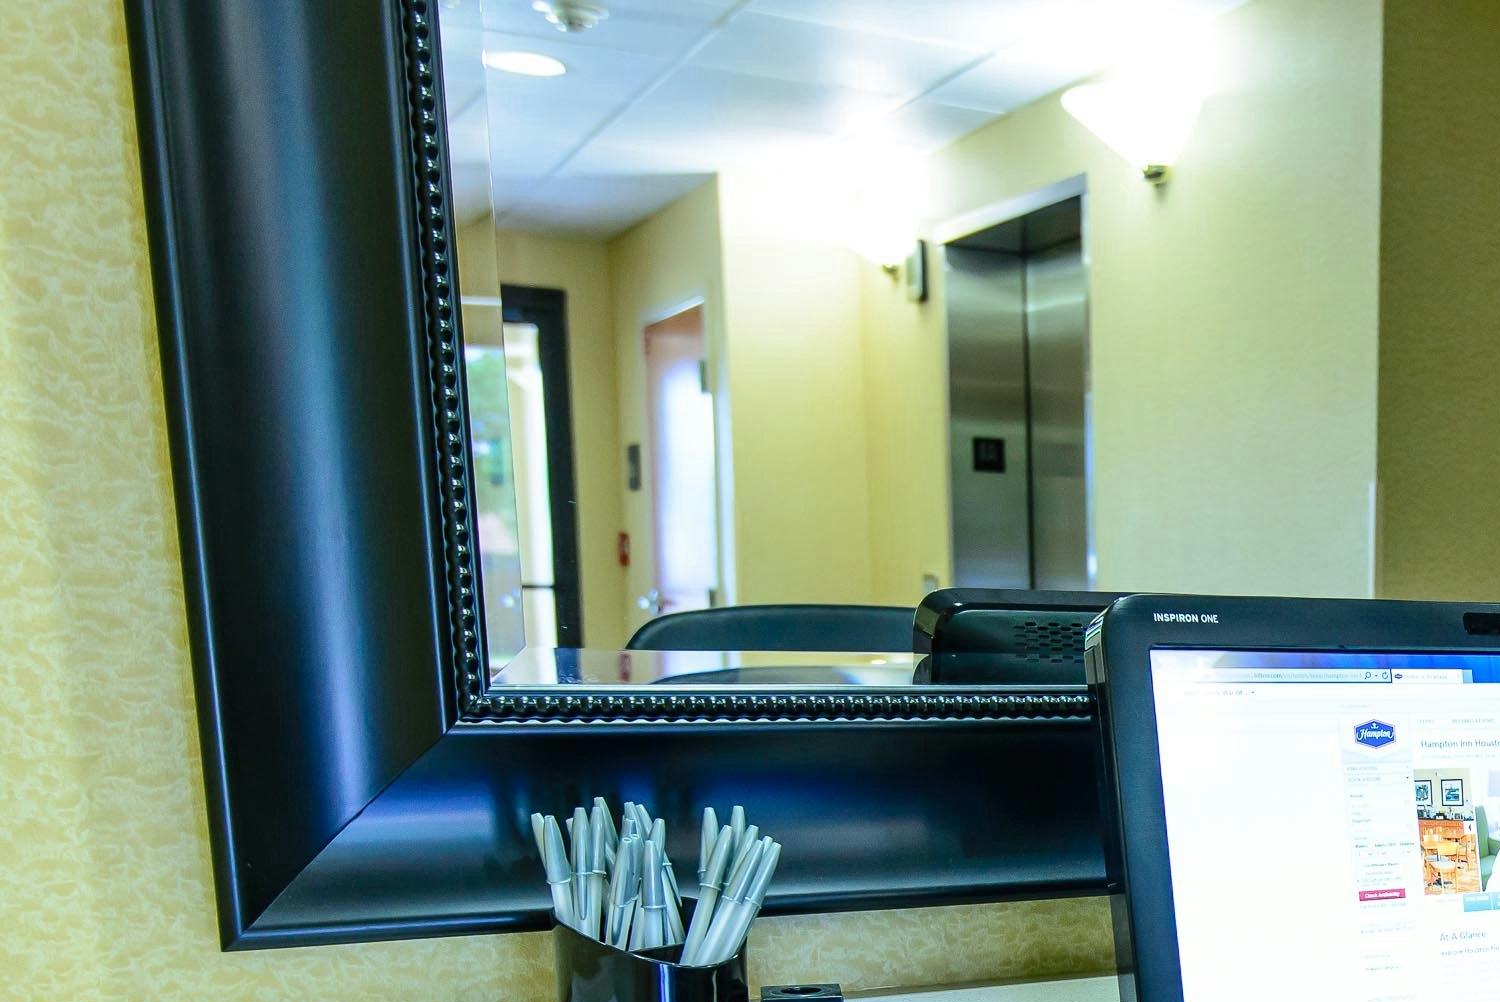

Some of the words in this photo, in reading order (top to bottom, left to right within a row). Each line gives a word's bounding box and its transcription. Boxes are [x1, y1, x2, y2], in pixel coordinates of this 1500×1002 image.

[1153, 612, 1199, 623] INSPIRON
[1200, 614, 1219, 624] ONE
[1356, 728, 1394, 741] Hampton
[1420, 739, 1458, 749] Hampton
